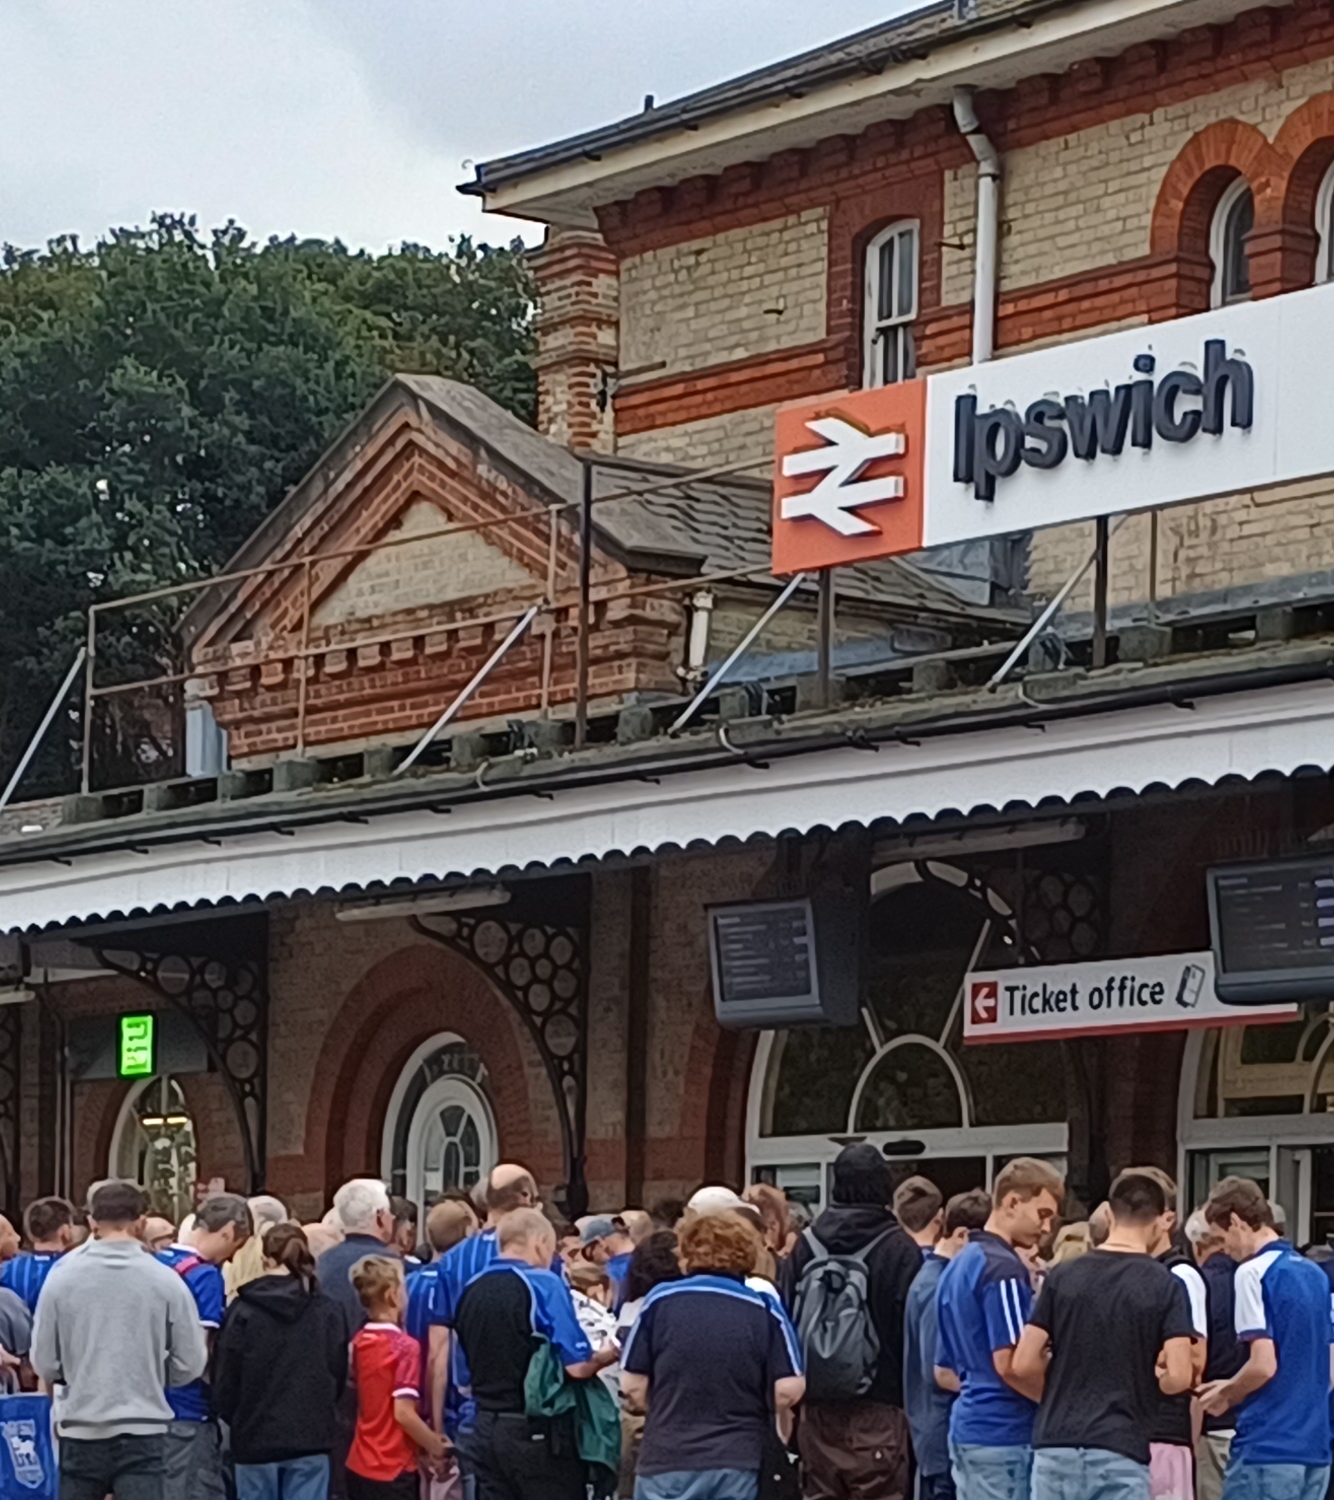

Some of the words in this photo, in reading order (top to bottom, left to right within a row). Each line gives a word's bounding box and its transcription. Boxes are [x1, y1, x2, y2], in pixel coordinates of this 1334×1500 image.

[954, 339, 1254, 502] Ipswich
[1004, 982, 1080, 1017] Ticket
[1088, 975, 1165, 1011] office
